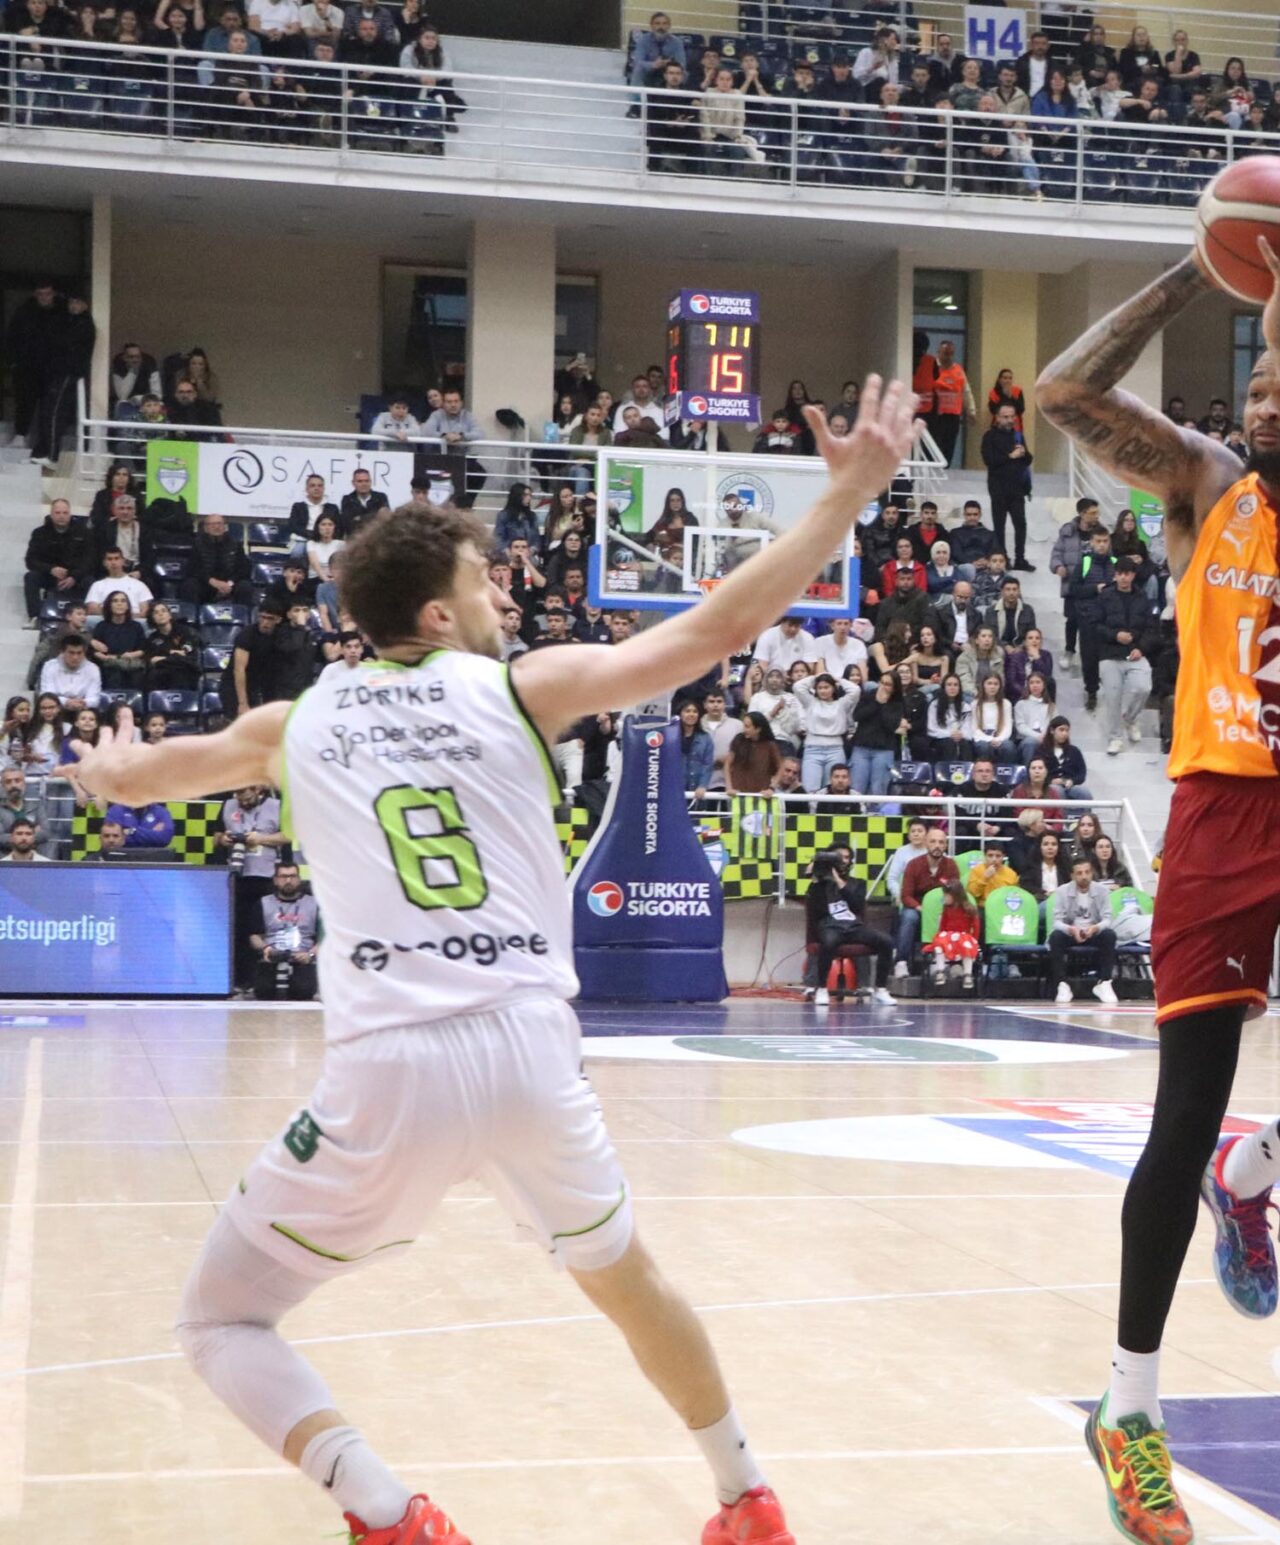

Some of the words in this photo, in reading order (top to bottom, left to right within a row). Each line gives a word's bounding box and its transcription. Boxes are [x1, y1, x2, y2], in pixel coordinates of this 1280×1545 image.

[968, 17, 1024, 57] H4
[705, 324, 717, 346] 7
[711, 354, 743, 392] 15
[374, 783, 489, 911] 6
